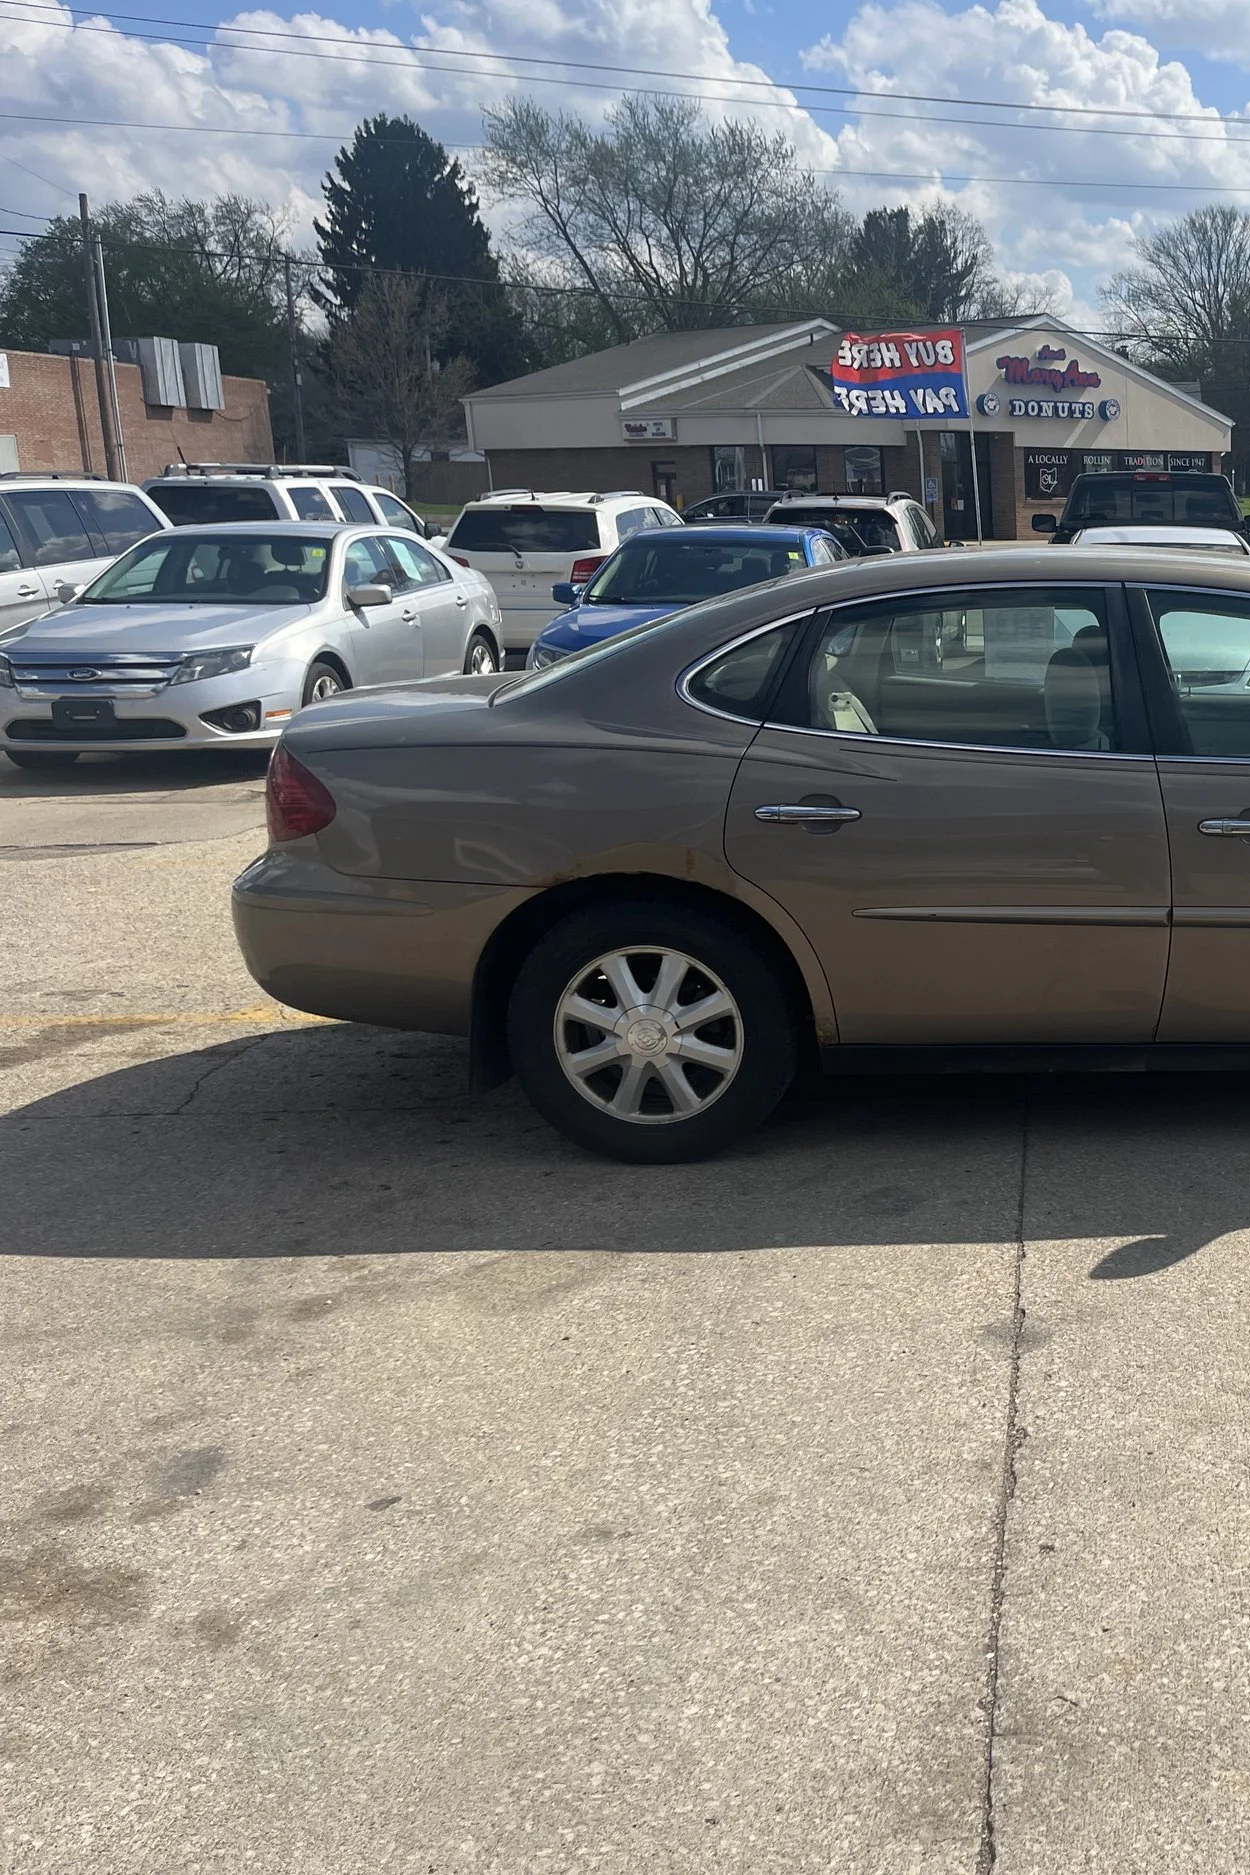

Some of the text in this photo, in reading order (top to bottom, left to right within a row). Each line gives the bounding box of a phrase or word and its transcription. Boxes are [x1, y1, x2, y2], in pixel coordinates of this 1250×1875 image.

[996, 355, 1101, 393] Mary Ann
[1012, 400, 1094, 419] DONUTS
[1027, 455, 1034, 464] A
[1035, 455, 1069, 465] LOCALLY
[1124, 456, 1164, 466] TRADITION
[1170, 457, 1190, 467] SINCE
[1191, 458, 1206, 467] 1947
